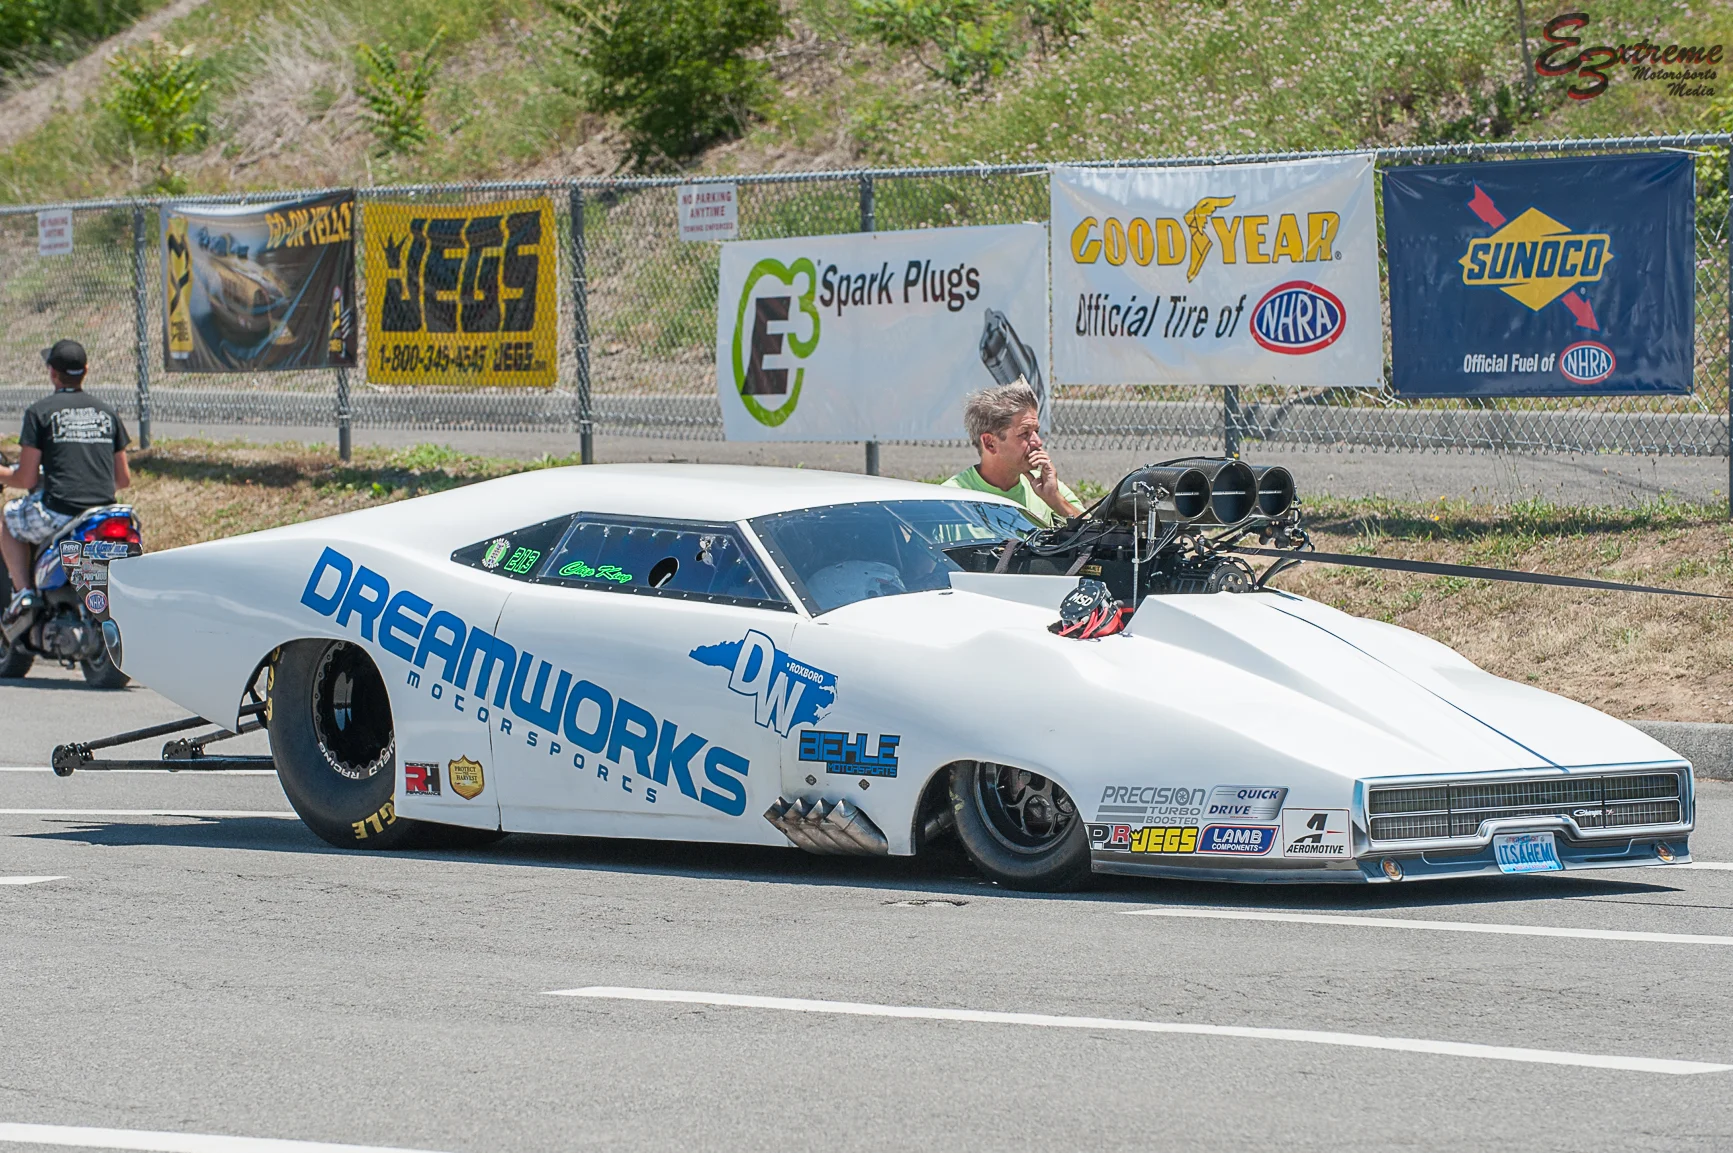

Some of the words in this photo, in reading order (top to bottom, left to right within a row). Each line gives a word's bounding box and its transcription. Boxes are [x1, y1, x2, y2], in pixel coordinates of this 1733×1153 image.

[696, 191, 732, 204] PARKING
[690, 206, 725, 218] ANYTIME
[1070, 211, 1340, 267] GOODYEAR
[1467, 238, 1607, 280] SUNOCO
[382, 211, 542, 332] JEGS
[819, 261, 896, 317] Spark
[903, 259, 981, 312] Plugs
[1075, 294, 1160, 337] Official
[1164, 295, 1209, 338] Tire
[1215, 295, 1247, 338] of
[1261, 294, 1333, 342] NHRA
[379, 344, 487, 373] 1-800-345-4545
[1463, 354, 1507, 373] Official
[1511, 354, 1539, 373] Fuel
[1541, 353, 1555, 373] of
[1567, 348, 1608, 377] NHRA
[504, 547, 541, 574] 213
[595, 565, 632, 583] King
[90, 595, 105, 609] NHRA
[1069, 592, 1093, 606] MSD
[301, 547, 749, 816] DREAMWORKS
[728, 629, 807, 739] DW
[789, 661, 824, 685] ROXBORO
[406, 670, 657, 804] MOTORSPORTS
[798, 730, 901, 764] BIEHLE
[318, 741, 360, 779] RACING
[827, 762, 897, 776] MOTORSPORTS
[406, 766, 441, 791] RH
[1101, 786, 1206, 806] PRECISION
[1237, 789, 1279, 800] QUICK
[1146, 816, 1199, 825] BOOSTED
[1149, 806, 1200, 816] TURBO
[1208, 805, 1251, 815] DRIVE
[1131, 828, 1198, 852] JEGS
[1211, 843, 1258, 852] COMPONENTS
[1213, 829, 1263, 844] LAMB
[1286, 844, 1344, 854] AEROMOTIVE
[1498, 842, 1556, 866] ITSAHEMI
